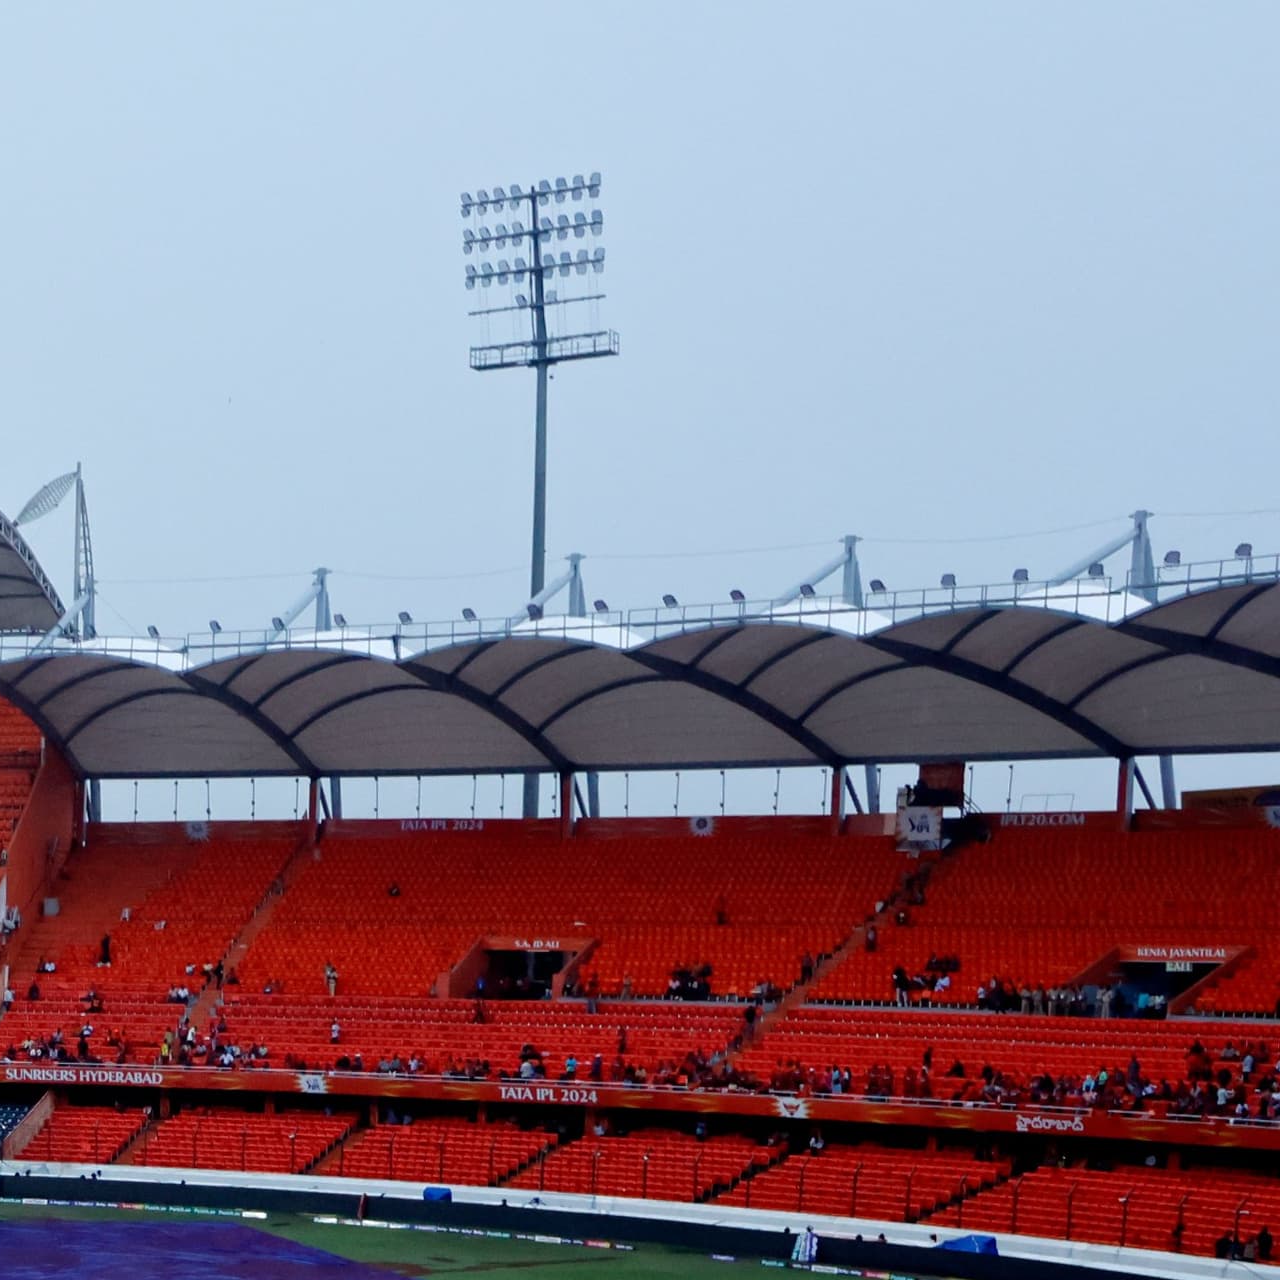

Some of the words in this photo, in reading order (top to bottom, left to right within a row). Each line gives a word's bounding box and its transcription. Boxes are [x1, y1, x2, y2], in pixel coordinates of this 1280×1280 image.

[400, 820, 429, 832] TATA
[452, 820, 484, 832] 2024
[1000, 814, 1085, 826] IPLT20.COM
[5, 1069, 77, 1083] SUNRISERS
[79, 1070, 164, 1085] HYDERABAD
[499, 1086, 534, 1100] TATA
[536, 1088, 557, 1101] IPL
[560, 1089, 599, 1104] 2024
